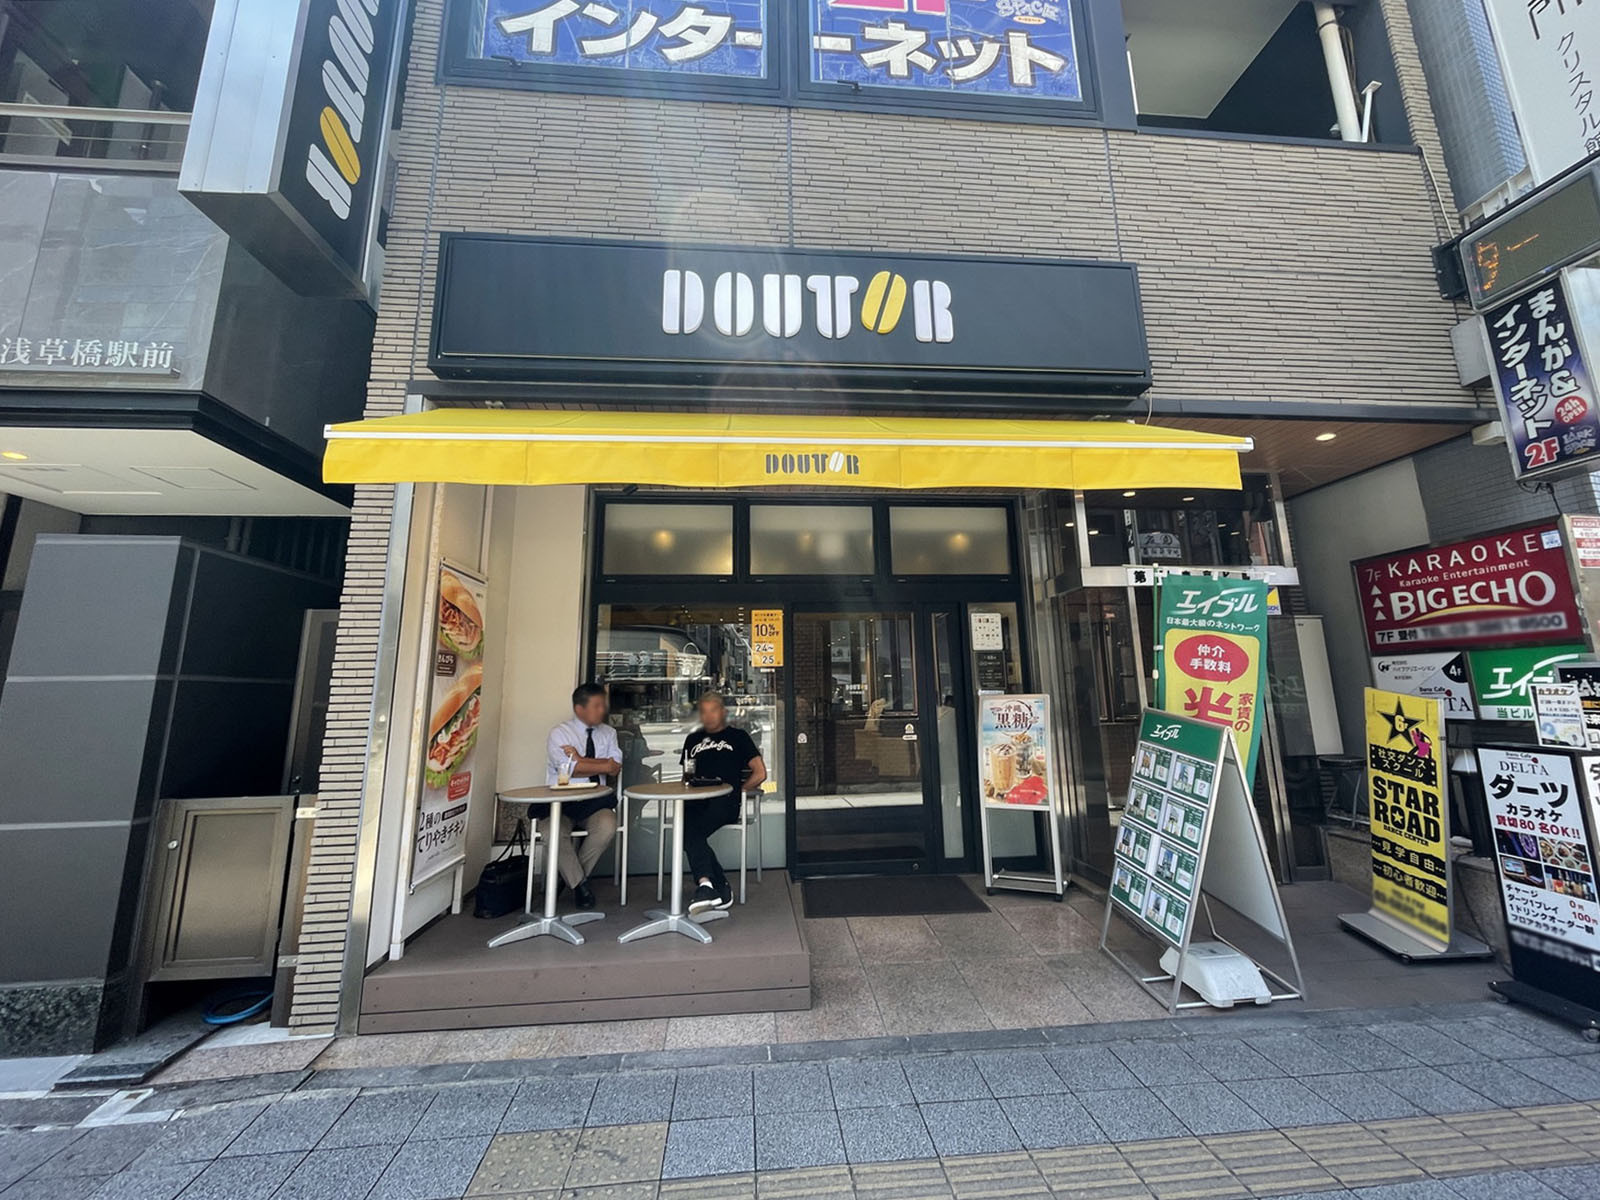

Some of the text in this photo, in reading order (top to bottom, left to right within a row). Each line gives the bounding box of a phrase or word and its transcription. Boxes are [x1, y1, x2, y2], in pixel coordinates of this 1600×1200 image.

[662, 269, 954, 342] DOUTOR
[0, 337, 174, 368] 浅草橋駅前
[1493, 304, 1553, 439] インターネット
[1556, 399, 1580, 417] 24h
[1563, 405, 1585, 423] OPEN
[765, 451, 859, 474] DOUTOR
[1525, 436, 1560, 469] 2F
[1365, 569, 1382, 583] 7F
[1387, 534, 1539, 579] KARAOKE
[1399, 559, 1530, 588] Karaoke Entertainment
[1172, 588, 1258, 618] エイブル
[1166, 617, 1260, 632] 日本最大級のネットワーク
[1377, 631, 1395, 643] 7F
[762, 655, 775, 664] 25
[1197, 644, 1225, 658] 仲介
[1189, 657, 1231, 674] 手数料
[1449, 665, 1461, 676] 4F
[995, 712, 1030, 729] 黒糖
[1234, 693, 1254, 733] 家賃の
[1150, 724, 1182, 740] エイブル
[1378, 748, 1426, 770] 社交ダンス
[1382, 760, 1424, 778] スクール
[1499, 761, 1549, 776] DELTA
[1373, 776, 1440, 819] STAR
[1489, 774, 1568, 808] ダーツ
[1374, 799, 1440, 843] ROAD
[1506, 803, 1562, 822] カラオケ
[417, 820, 465, 853] てりやきチキン
[1505, 884, 1538, 898] チャージ
